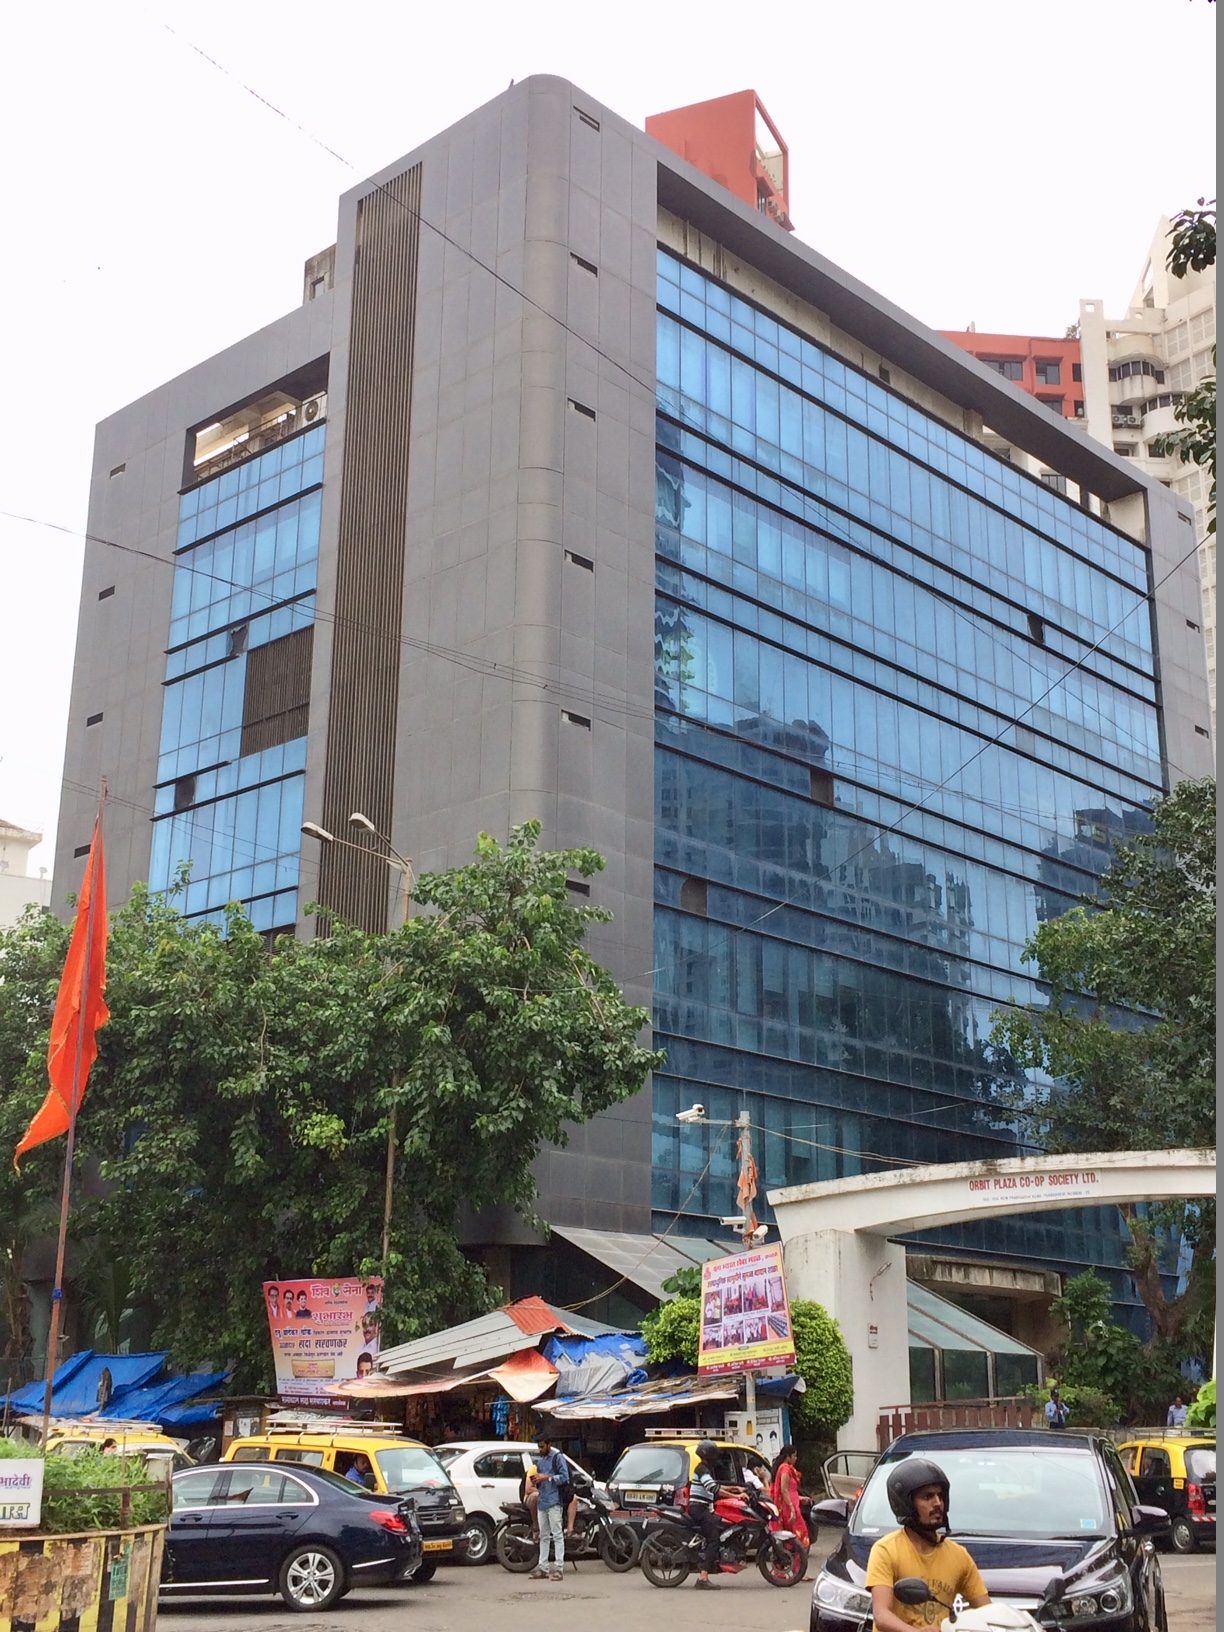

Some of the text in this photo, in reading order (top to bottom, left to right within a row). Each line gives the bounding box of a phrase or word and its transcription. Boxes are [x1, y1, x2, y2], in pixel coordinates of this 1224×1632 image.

[969, 1172, 1099, 1191] ORBIT PLAZA CO-OP SOCIETY LTD.
[312, 1308, 353, 1323] शुभारंभ
